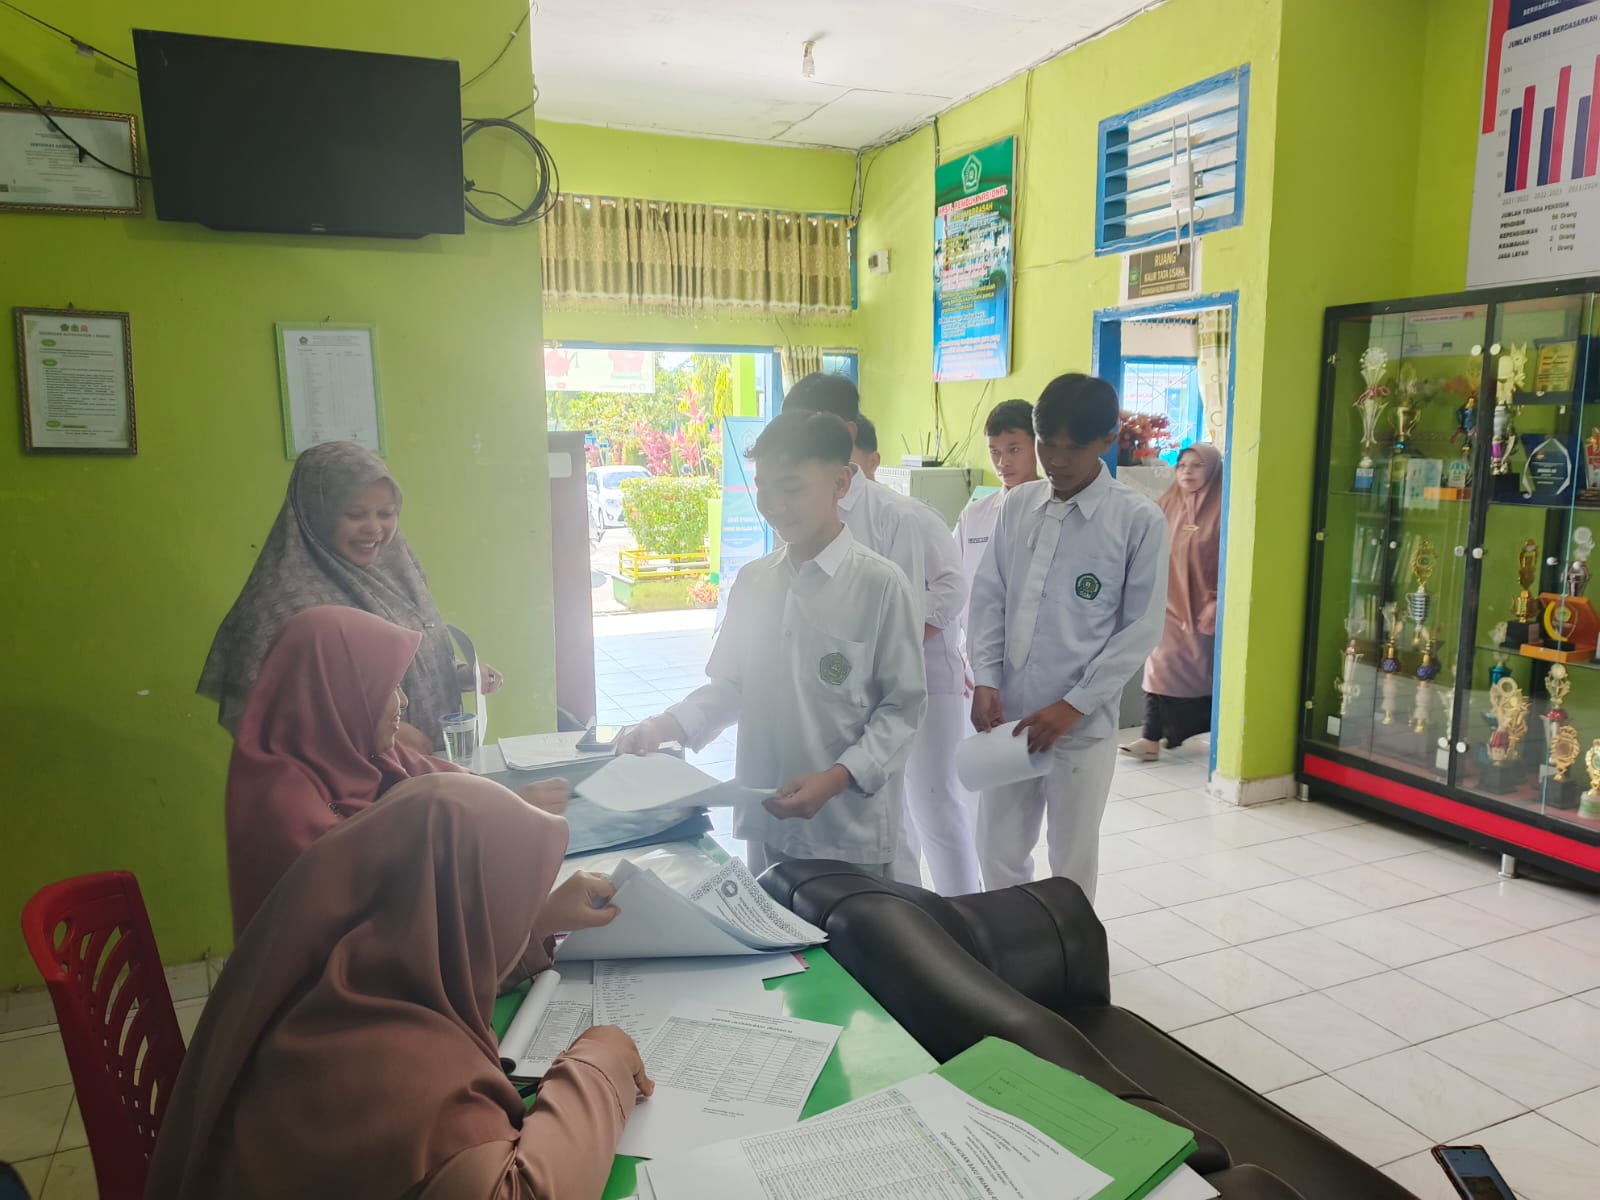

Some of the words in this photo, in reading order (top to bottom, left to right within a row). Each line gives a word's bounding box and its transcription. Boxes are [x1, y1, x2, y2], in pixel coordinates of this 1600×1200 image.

[1508, 35, 1532, 49] JUMLAH
[1533, 29, 1551, 41] SISWA
[1553, 15, 1598, 34] BERDASARKAN
[1523, 206, 1543, 215] TENAGA
[1560, 211, 1578, 220] Orang
[1154, 251, 1177, 267] RUANG
